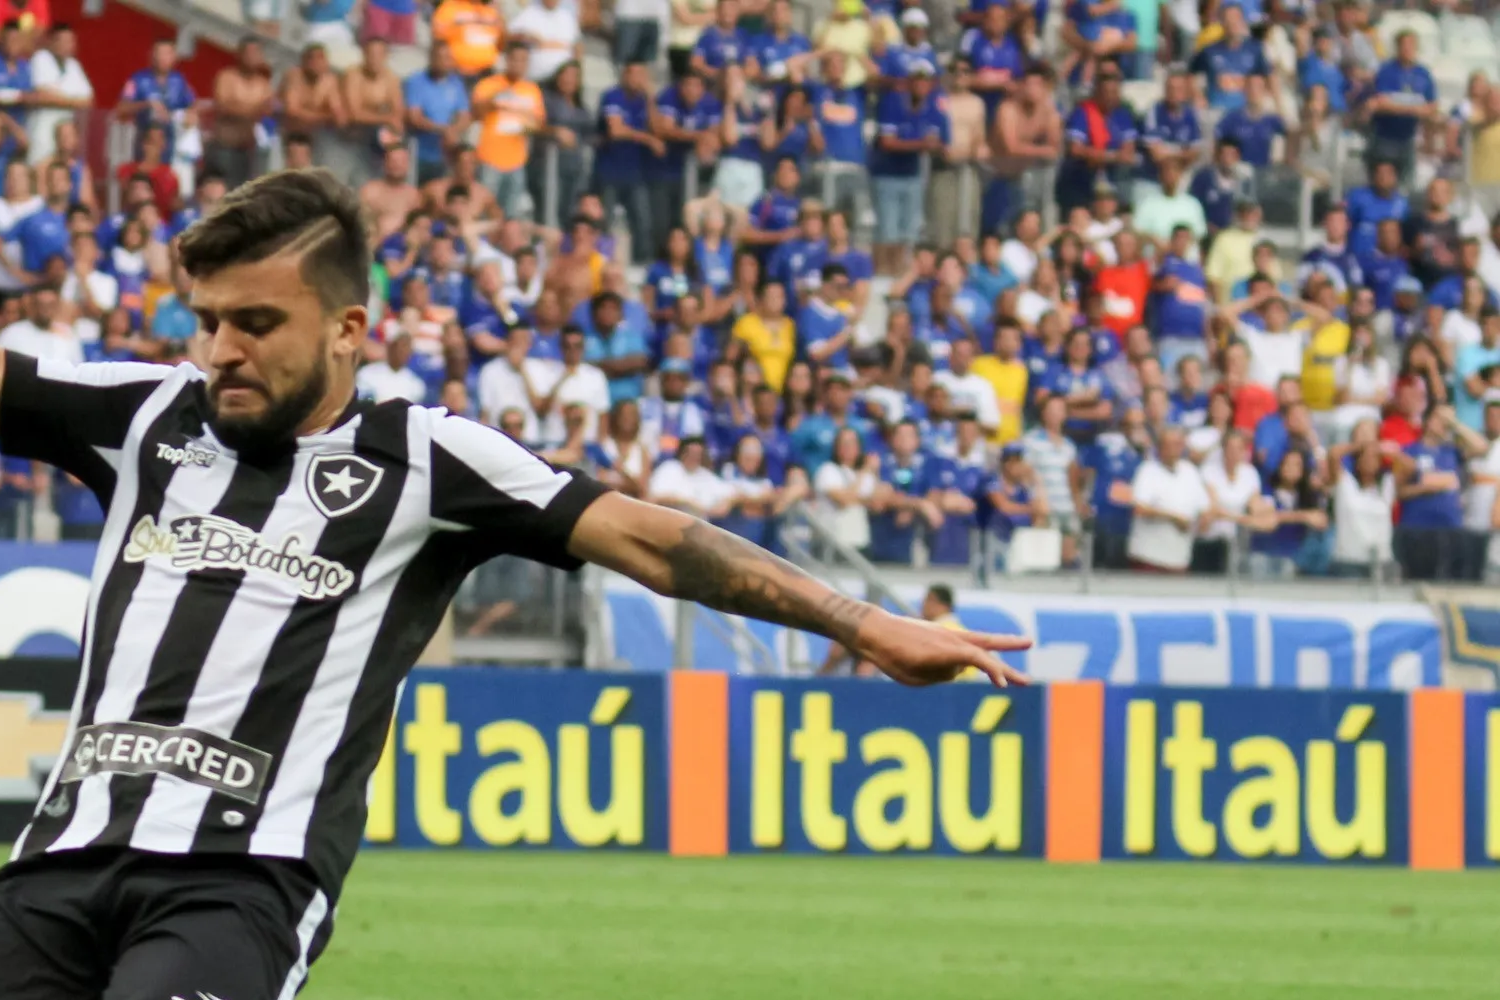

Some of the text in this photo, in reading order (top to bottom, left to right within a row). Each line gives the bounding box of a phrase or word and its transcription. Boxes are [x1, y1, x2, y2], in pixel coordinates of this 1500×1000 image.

[157, 443, 217, 467] Topper
[123, 515, 353, 599] Sou Botafogo
[95, 731, 256, 789] CERCRED
[364, 683, 645, 847] Itaú
[751, 689, 1023, 853] Itaú
[1123, 699, 1387, 860] Itaú
